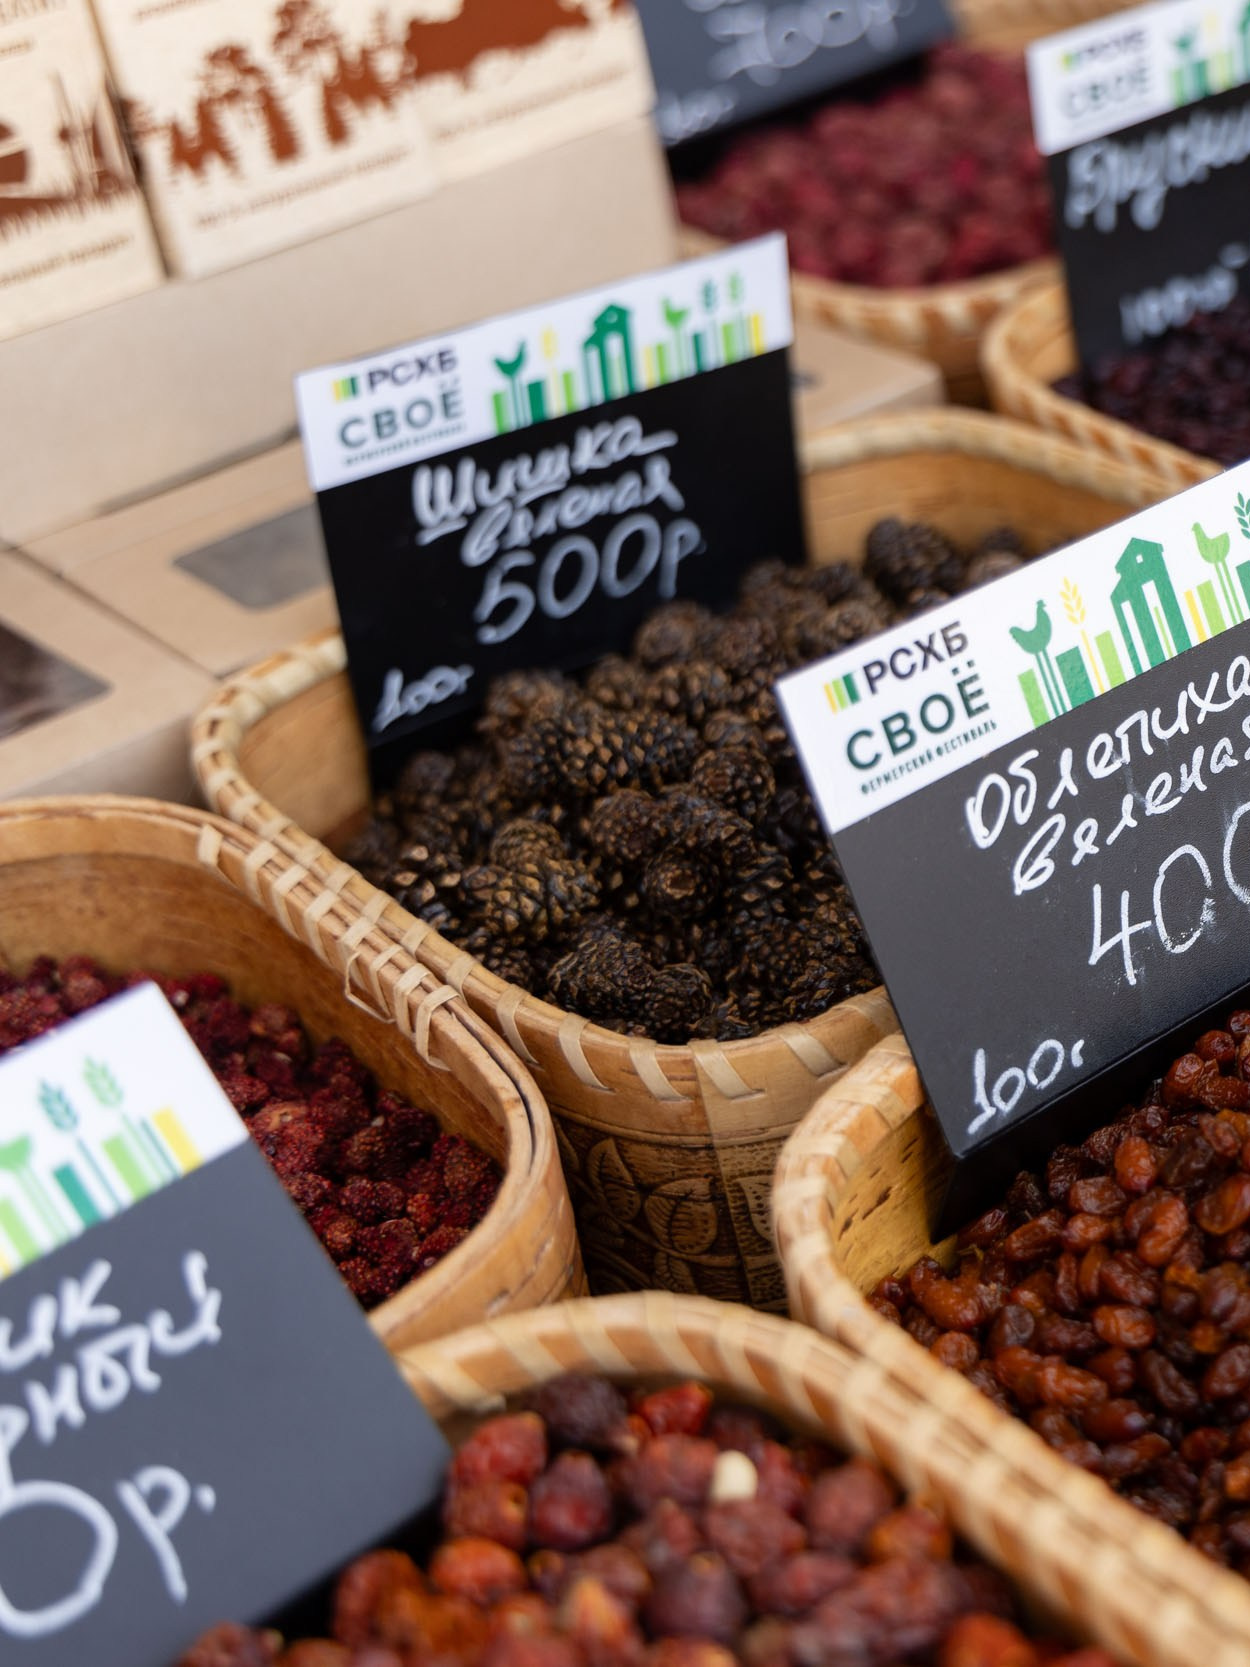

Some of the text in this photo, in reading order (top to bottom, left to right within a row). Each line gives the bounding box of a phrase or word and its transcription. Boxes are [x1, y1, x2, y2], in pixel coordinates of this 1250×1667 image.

[367, 349, 459, 393] РСХБ
[339, 377, 463, 450] СВОЁ
[412, 415, 679, 546] Шишка
[863, 620, 968, 695] РСХБ
[846, 659, 991, 771] СВОЁ
[861, 719, 998, 795] ФЕРМЕРСКИЙ ФЕСТИВАЛЬ
